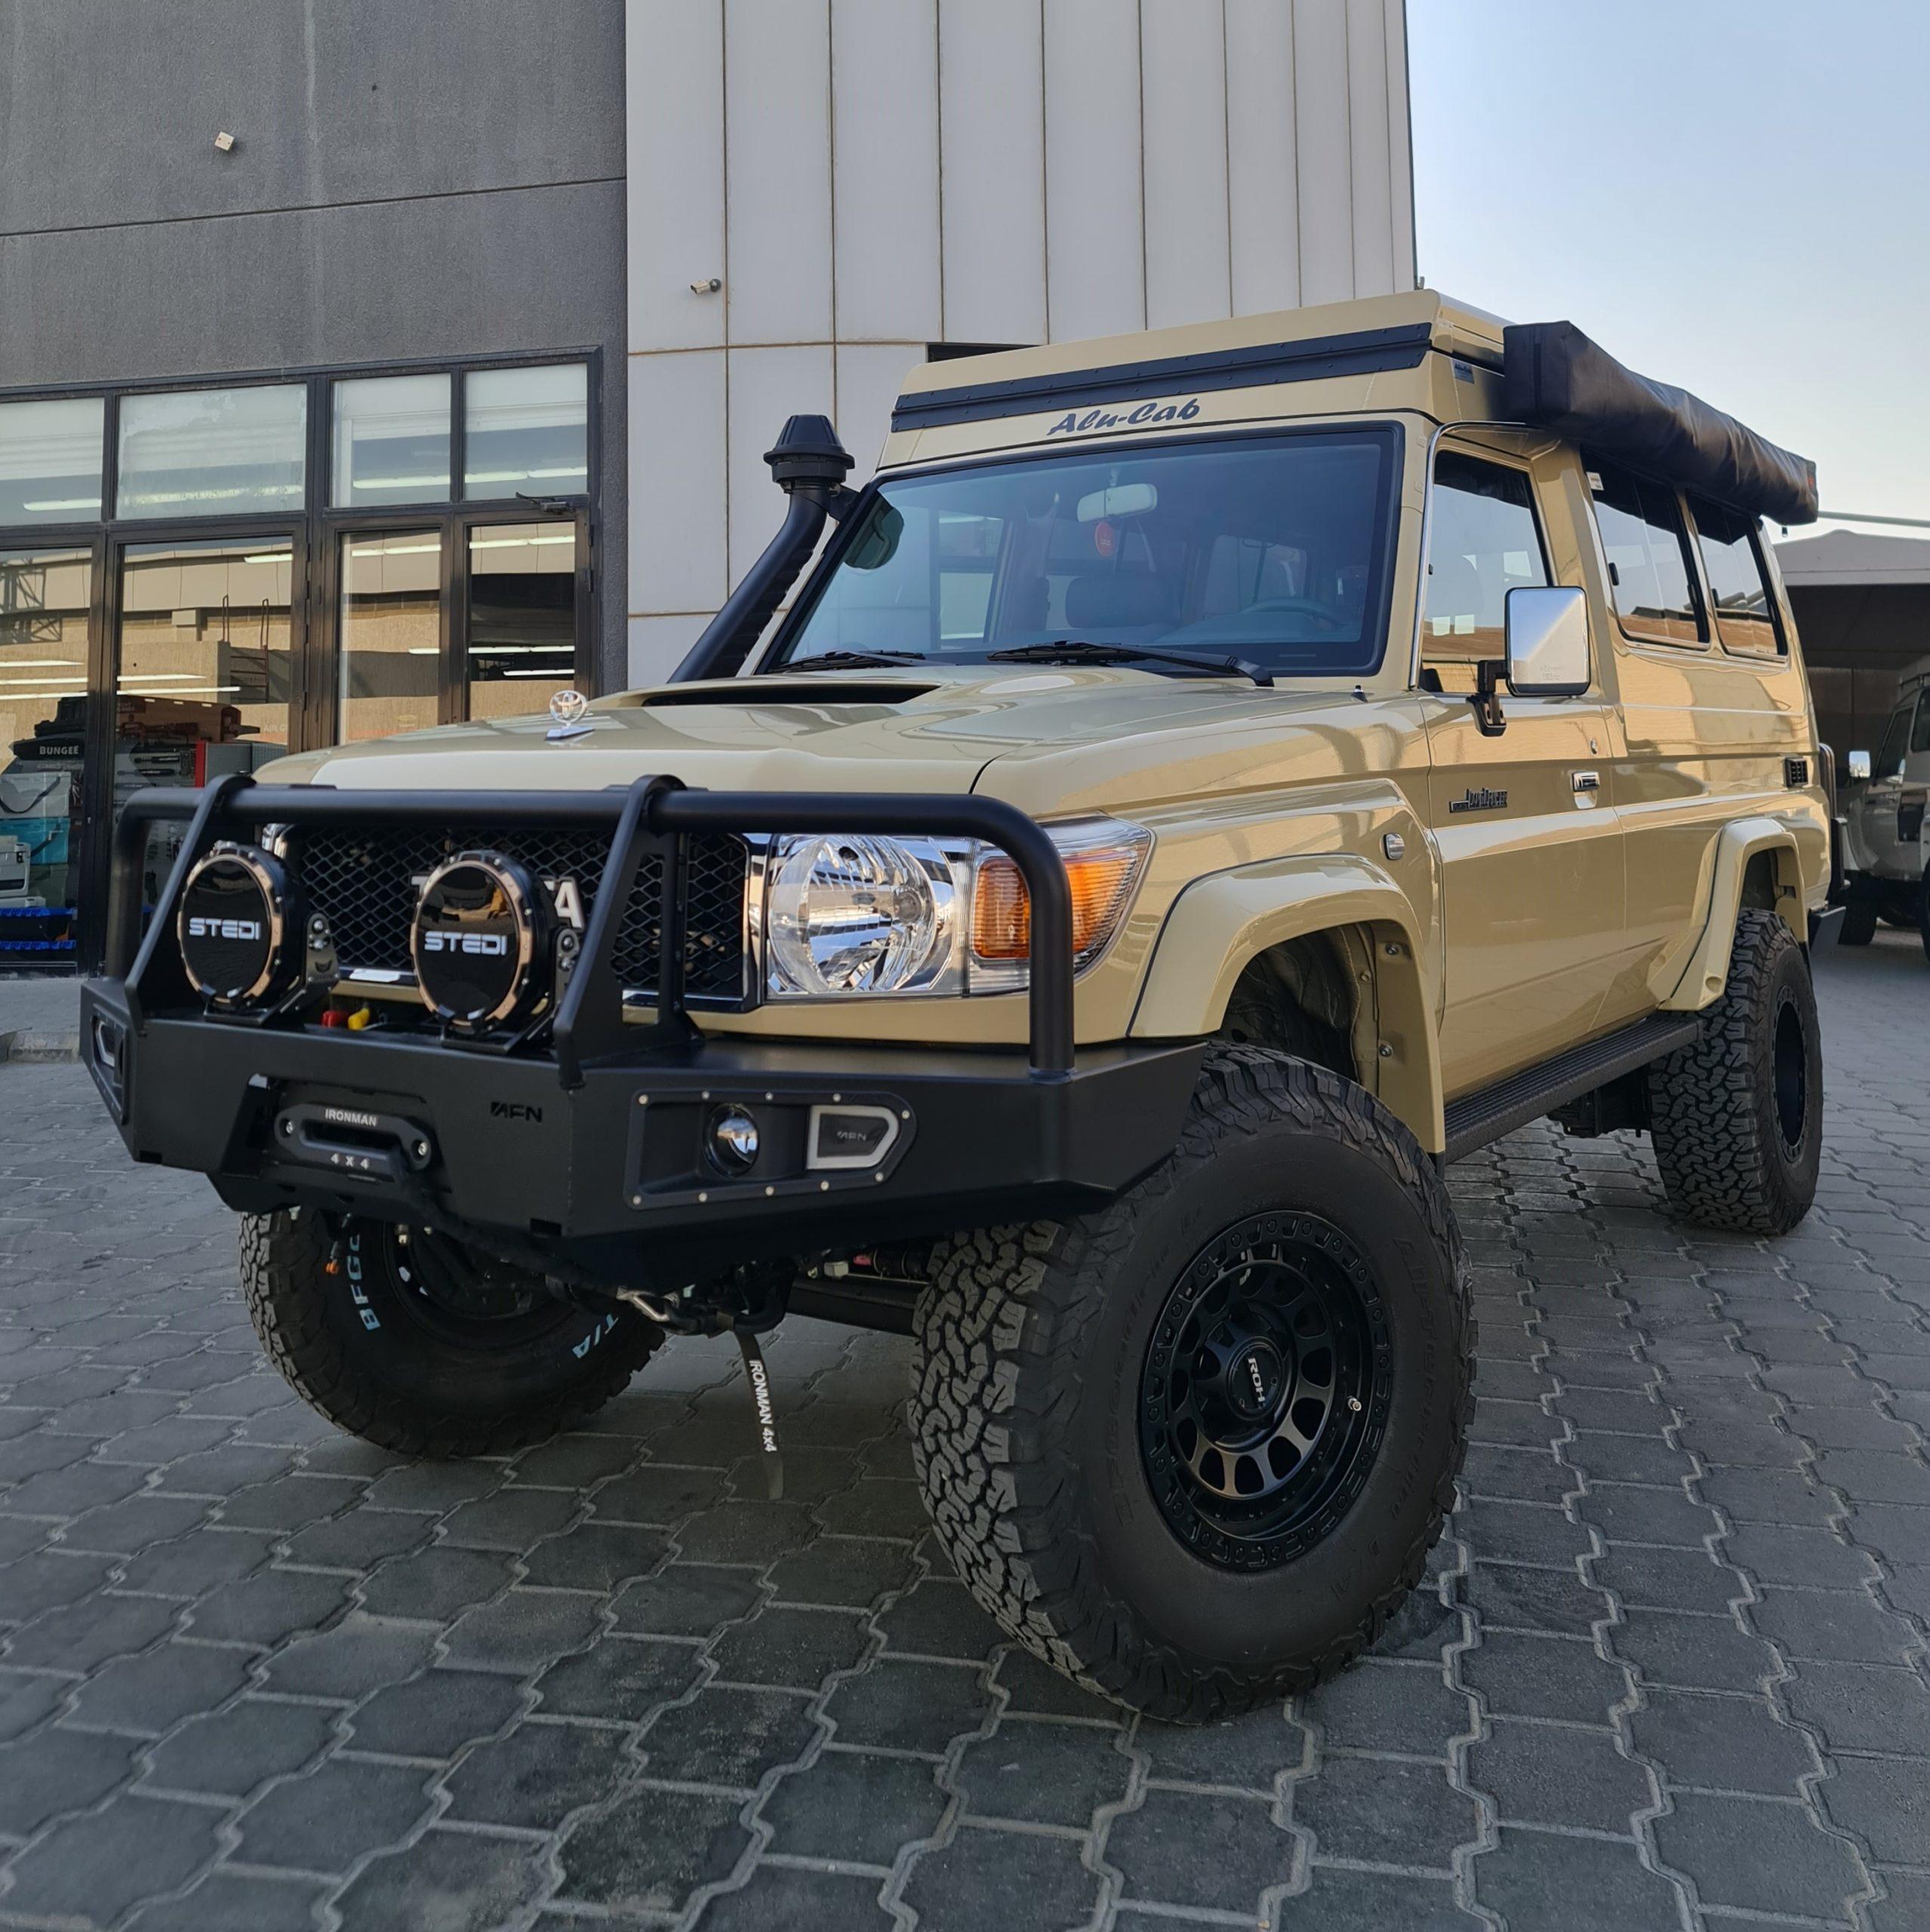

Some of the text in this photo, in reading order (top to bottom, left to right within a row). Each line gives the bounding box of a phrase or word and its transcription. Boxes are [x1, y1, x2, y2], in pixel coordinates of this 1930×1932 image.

[1046, 398, 1200, 435] Alu-Cab
[39, 746, 79, 755] BUNGEE
[189, 917, 260, 940] STEDI
[424, 931, 507, 956] STEDI
[325, 1108, 377, 1127] IRONMAN
[1248, 1358, 1266, 1402] ROH
[749, 1359, 777, 1452] IRONMAN 4x4
